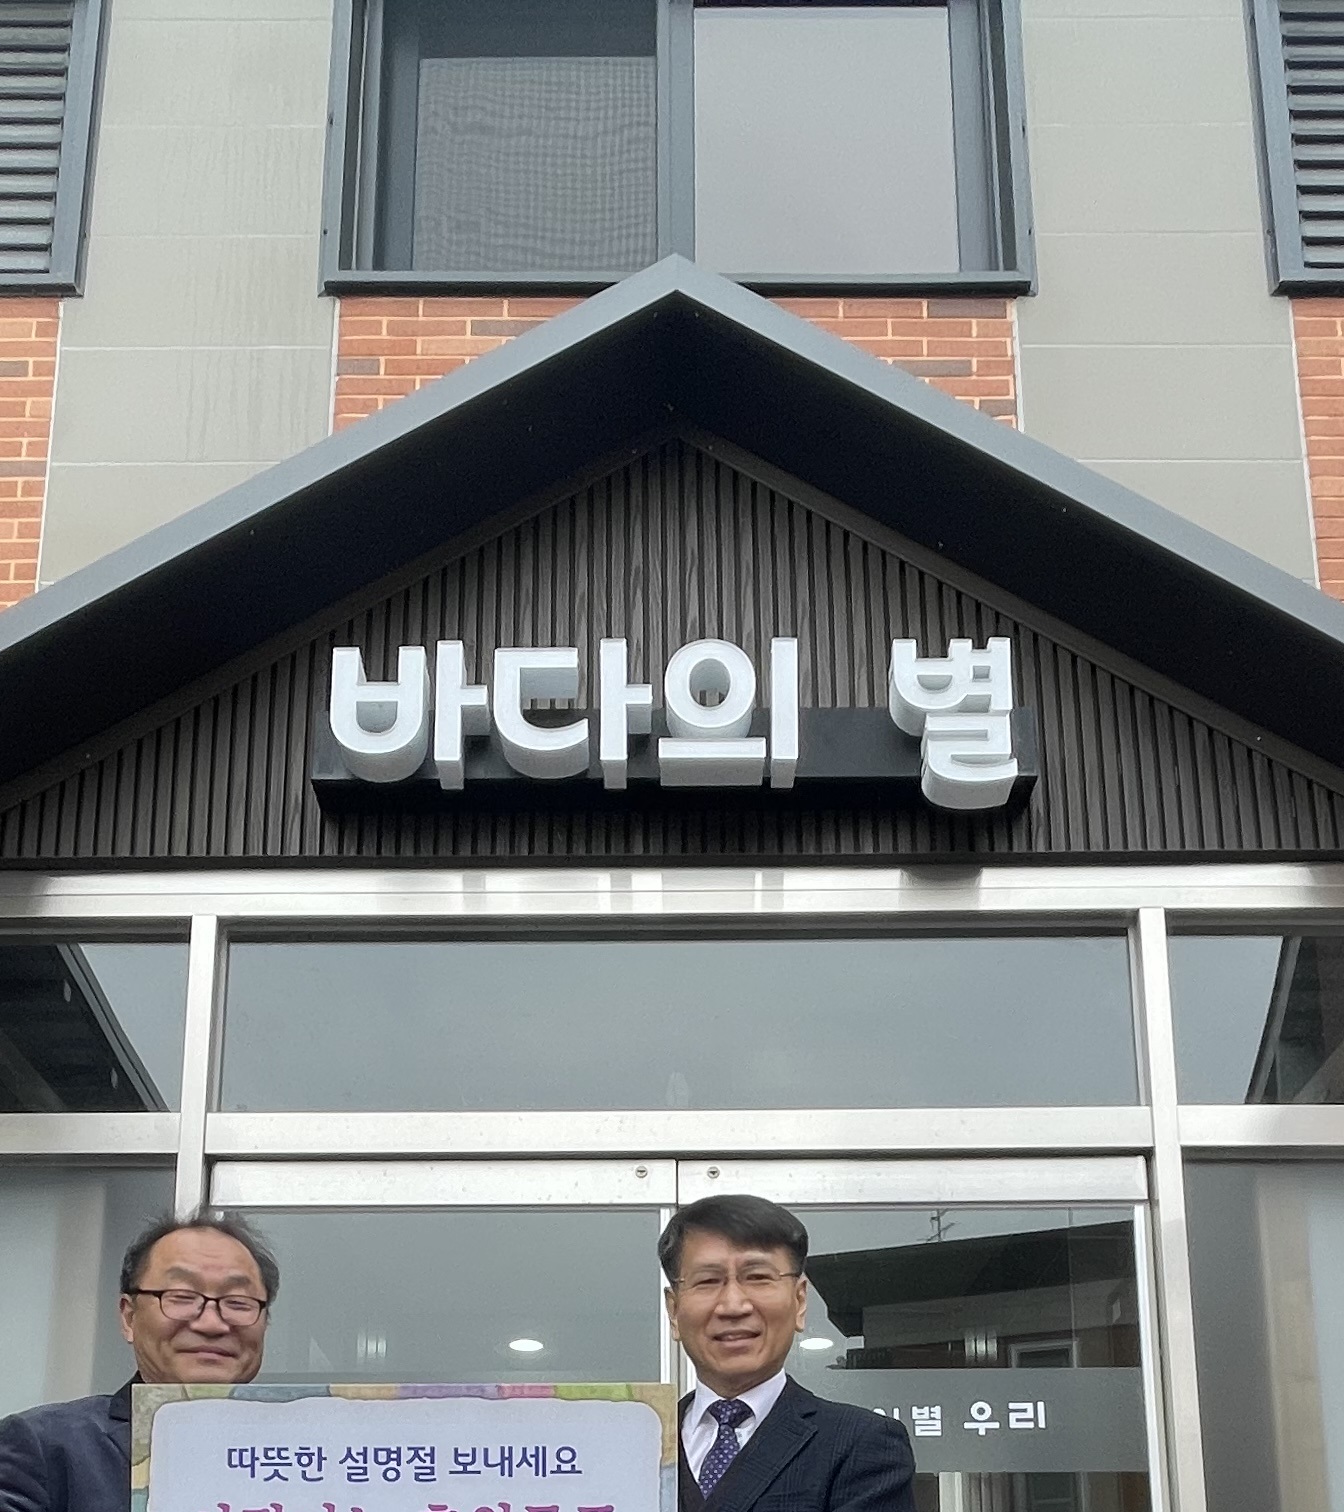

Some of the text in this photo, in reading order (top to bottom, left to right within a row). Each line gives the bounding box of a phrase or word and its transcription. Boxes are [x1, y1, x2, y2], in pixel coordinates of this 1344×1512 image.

[329, 636, 1019, 810] 바다의 별
[963, 1401, 1047, 1436] 우리
[227, 1443, 582, 1484] 따뜻한 설명절 보내세요
